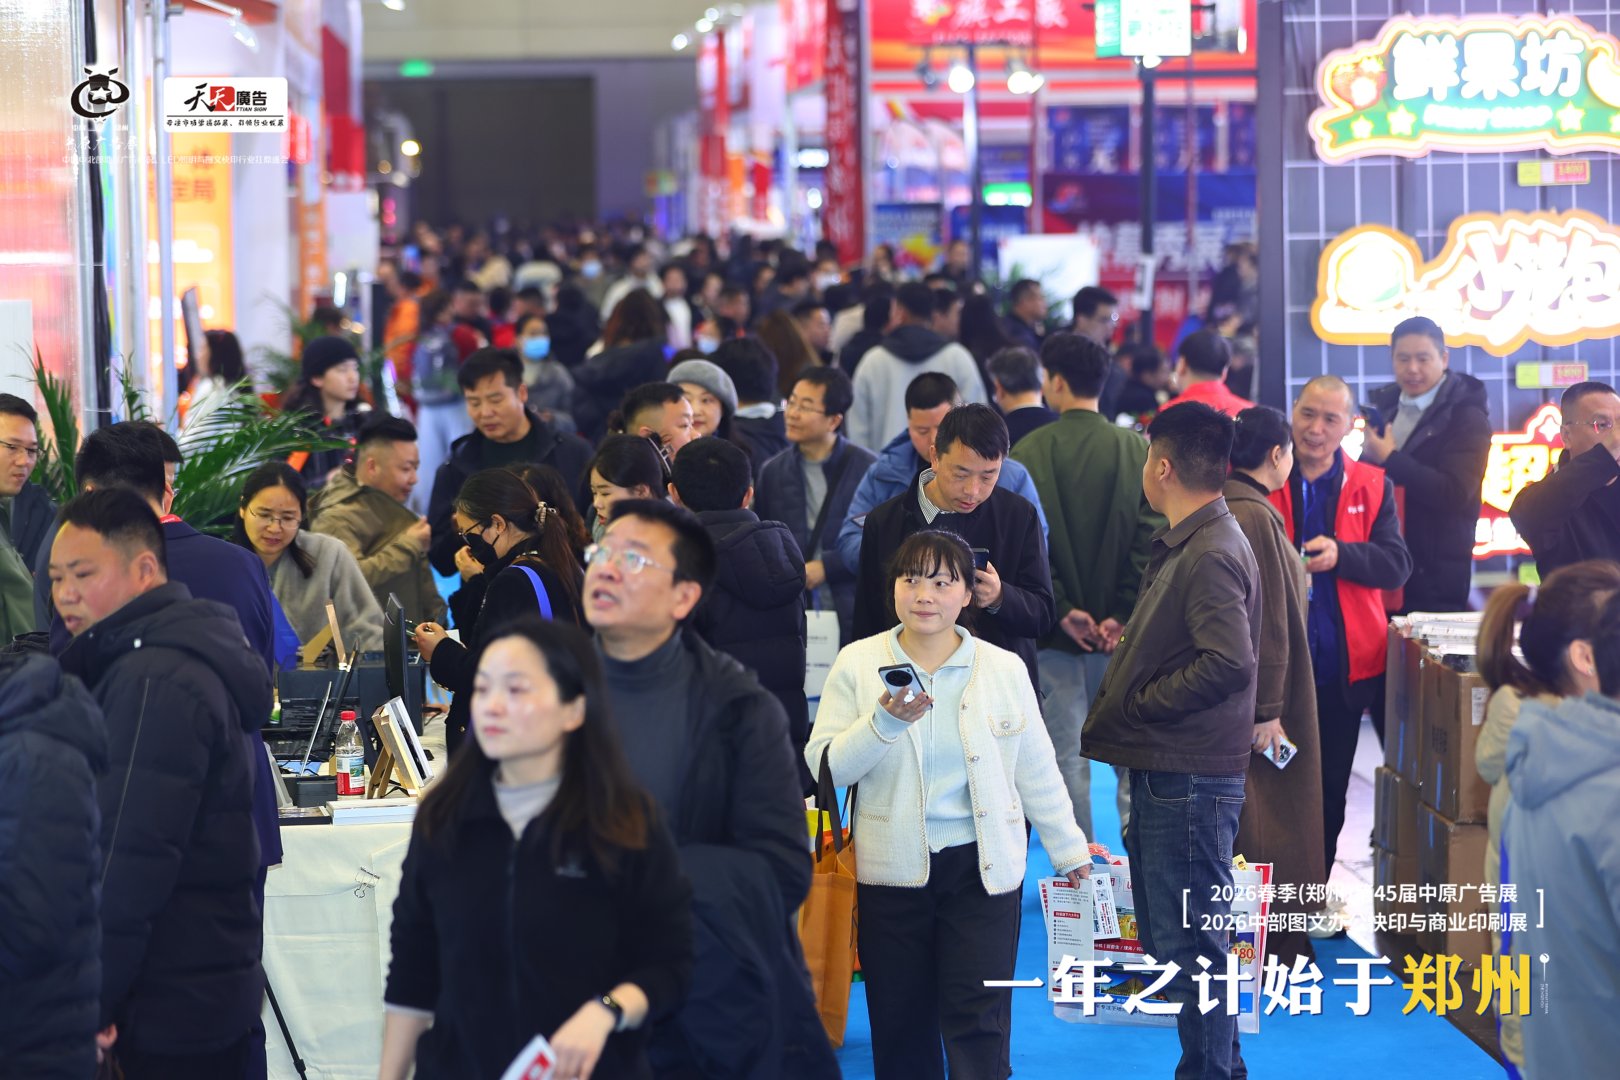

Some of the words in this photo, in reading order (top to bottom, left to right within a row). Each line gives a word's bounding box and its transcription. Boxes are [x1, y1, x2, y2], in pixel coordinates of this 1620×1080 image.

[1393, 30, 1584, 101] 鲜果坊
[1481, 442, 1563, 512] 超
